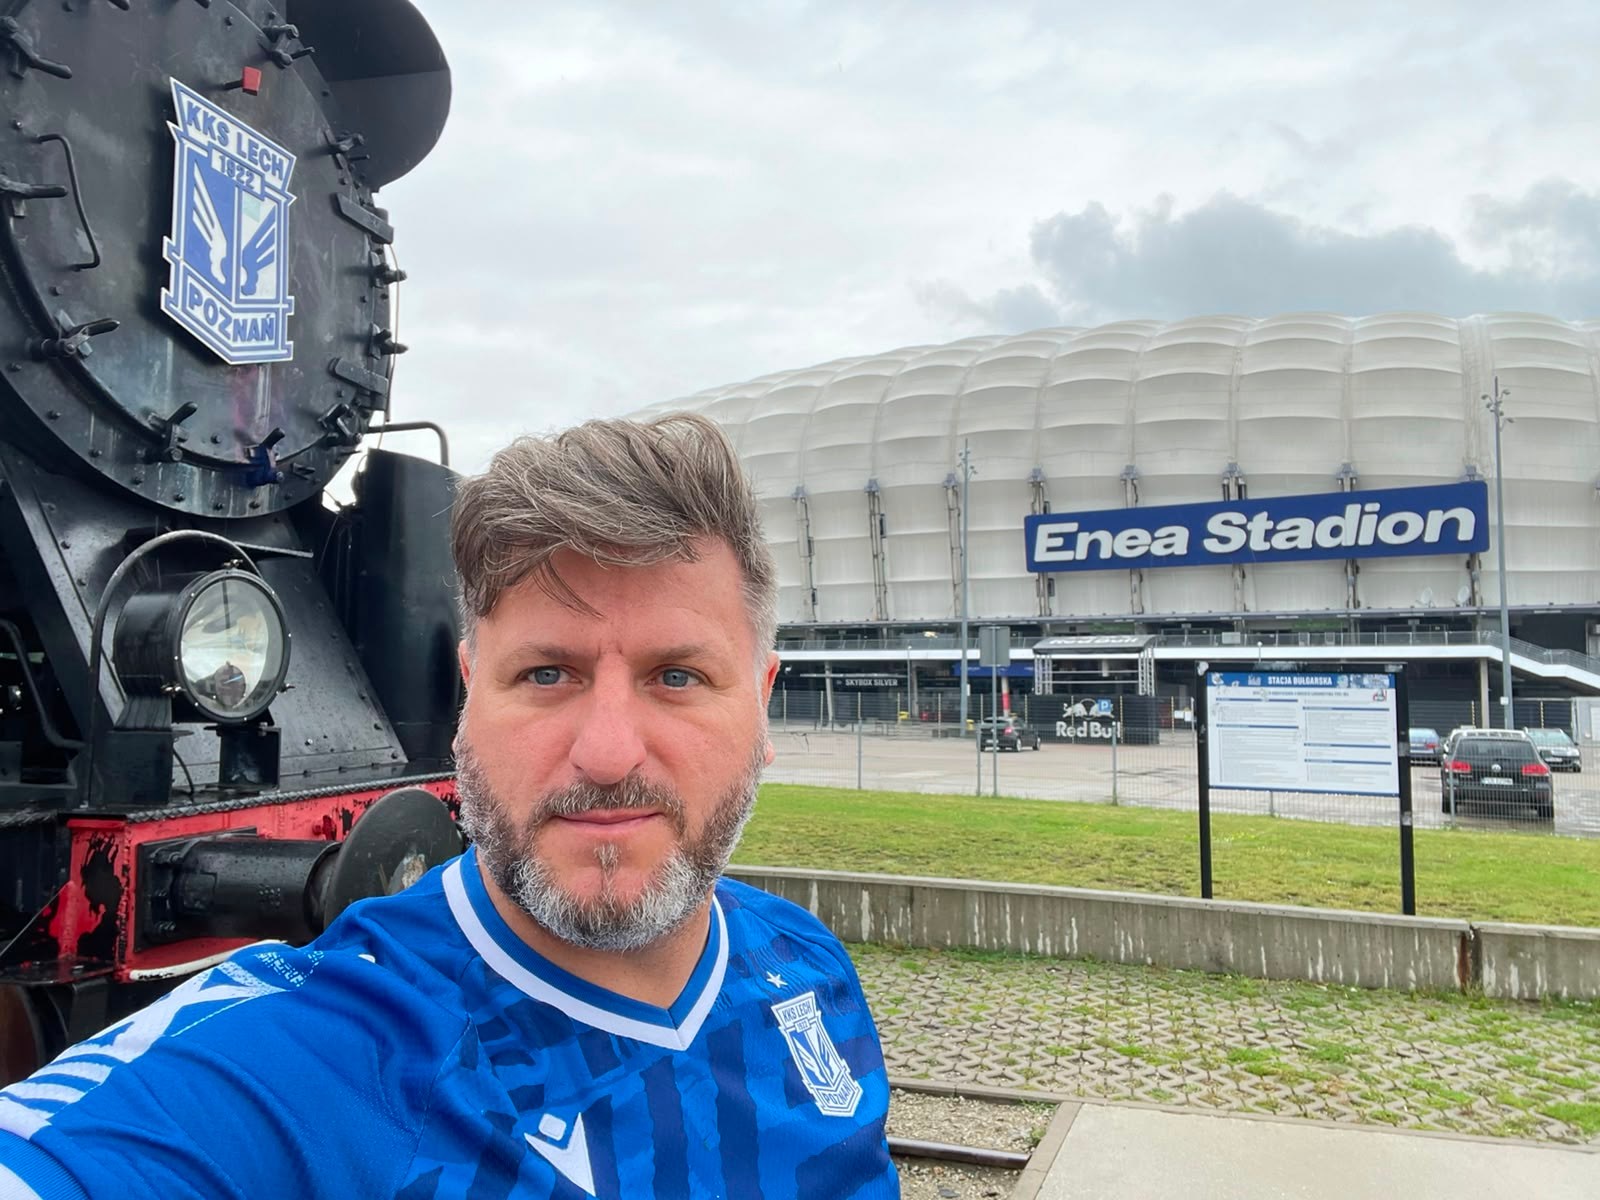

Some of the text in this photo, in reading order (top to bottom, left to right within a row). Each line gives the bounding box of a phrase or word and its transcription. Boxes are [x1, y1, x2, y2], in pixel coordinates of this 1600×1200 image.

[186, 101, 285, 181] KKS LECH
[218, 154, 255, 189] 1922
[188, 282, 275, 343] POZNAŃ
[1033, 502, 1476, 563] Enea Stadion
[1267, 675, 1292, 686] STACJA
[1101, 701, 1109, 710] P
[1056, 721, 1121, 739] Red Bul
[782, 1000, 812, 1022] KKS LECH
